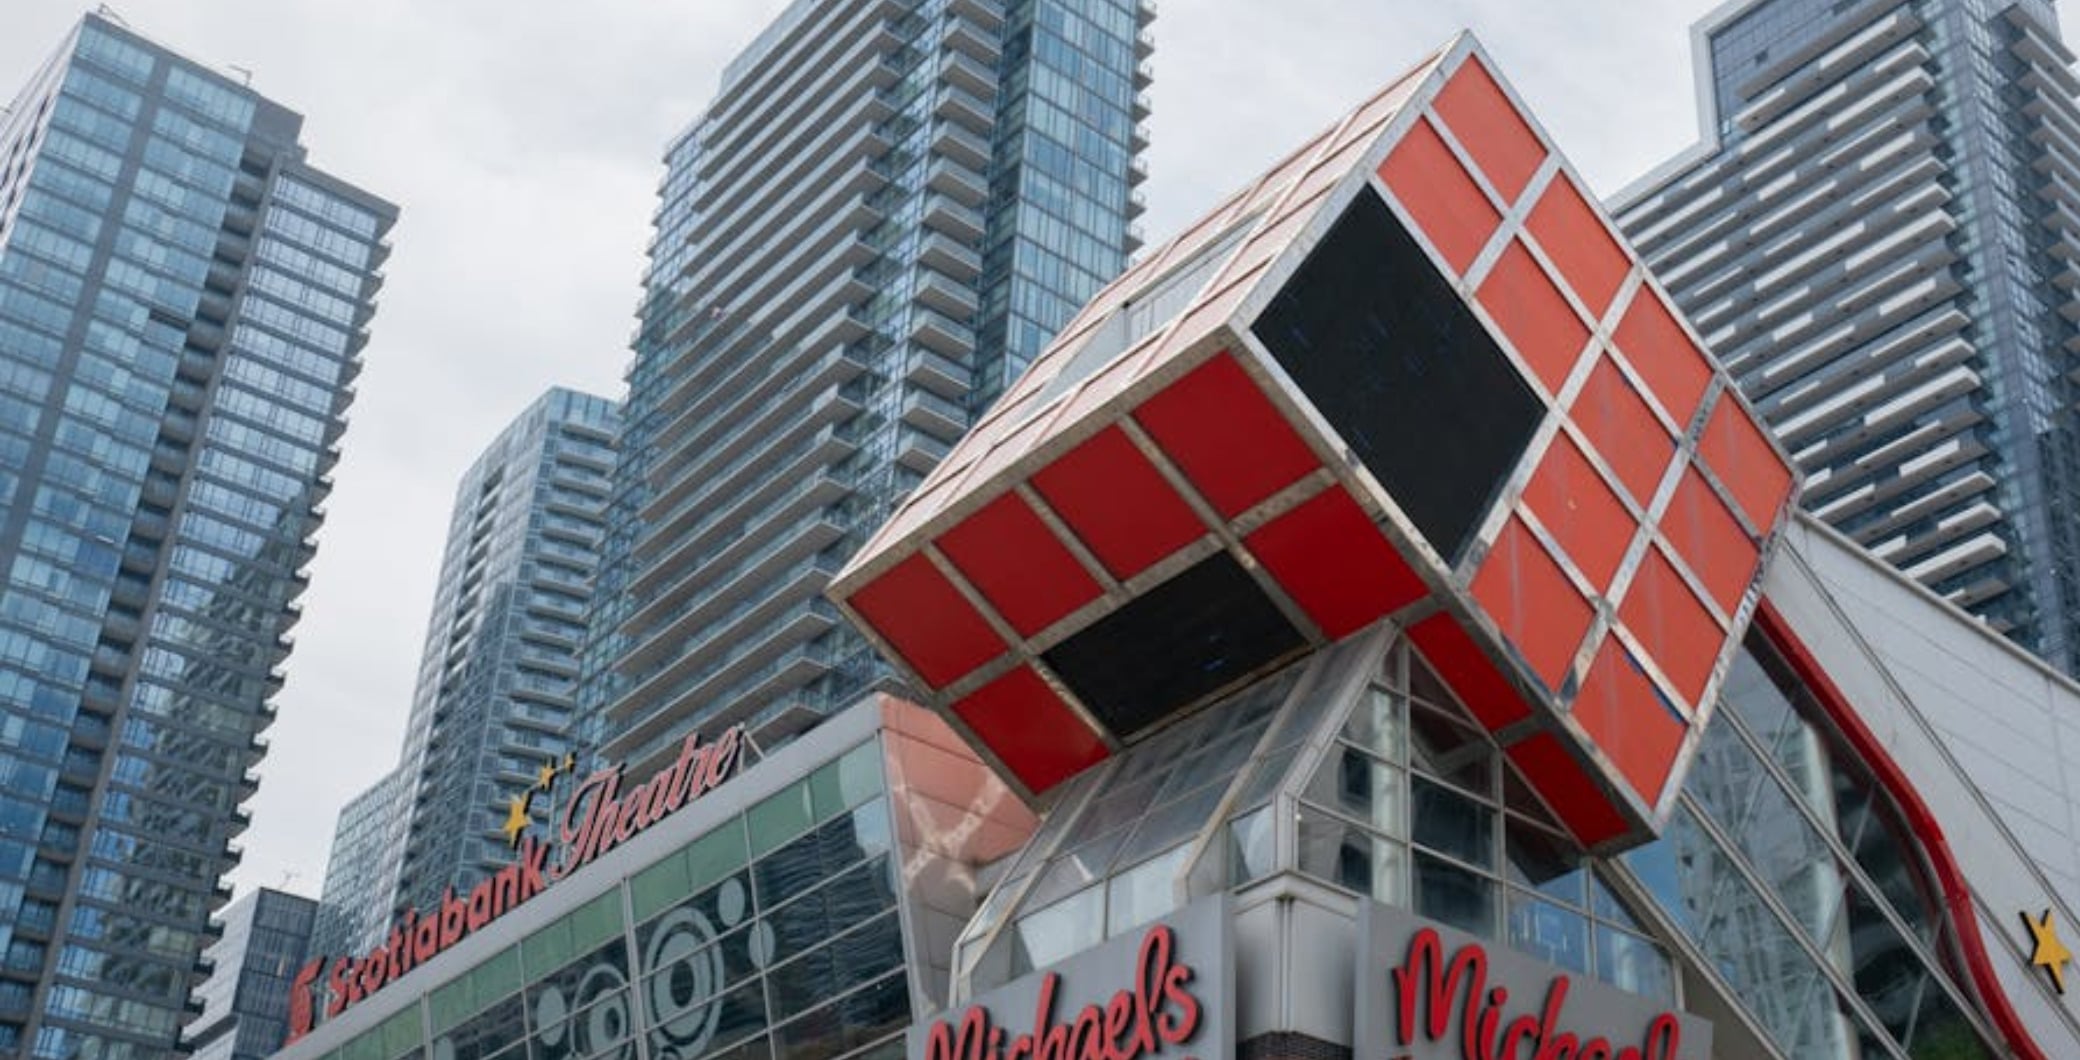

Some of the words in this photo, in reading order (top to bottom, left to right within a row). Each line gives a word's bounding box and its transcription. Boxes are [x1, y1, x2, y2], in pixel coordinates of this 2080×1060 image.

[328, 836, 547, 1018] Scotiabank
[549, 726, 738, 880] Theatre
[1392, 927, 1680, 1060] Mich
